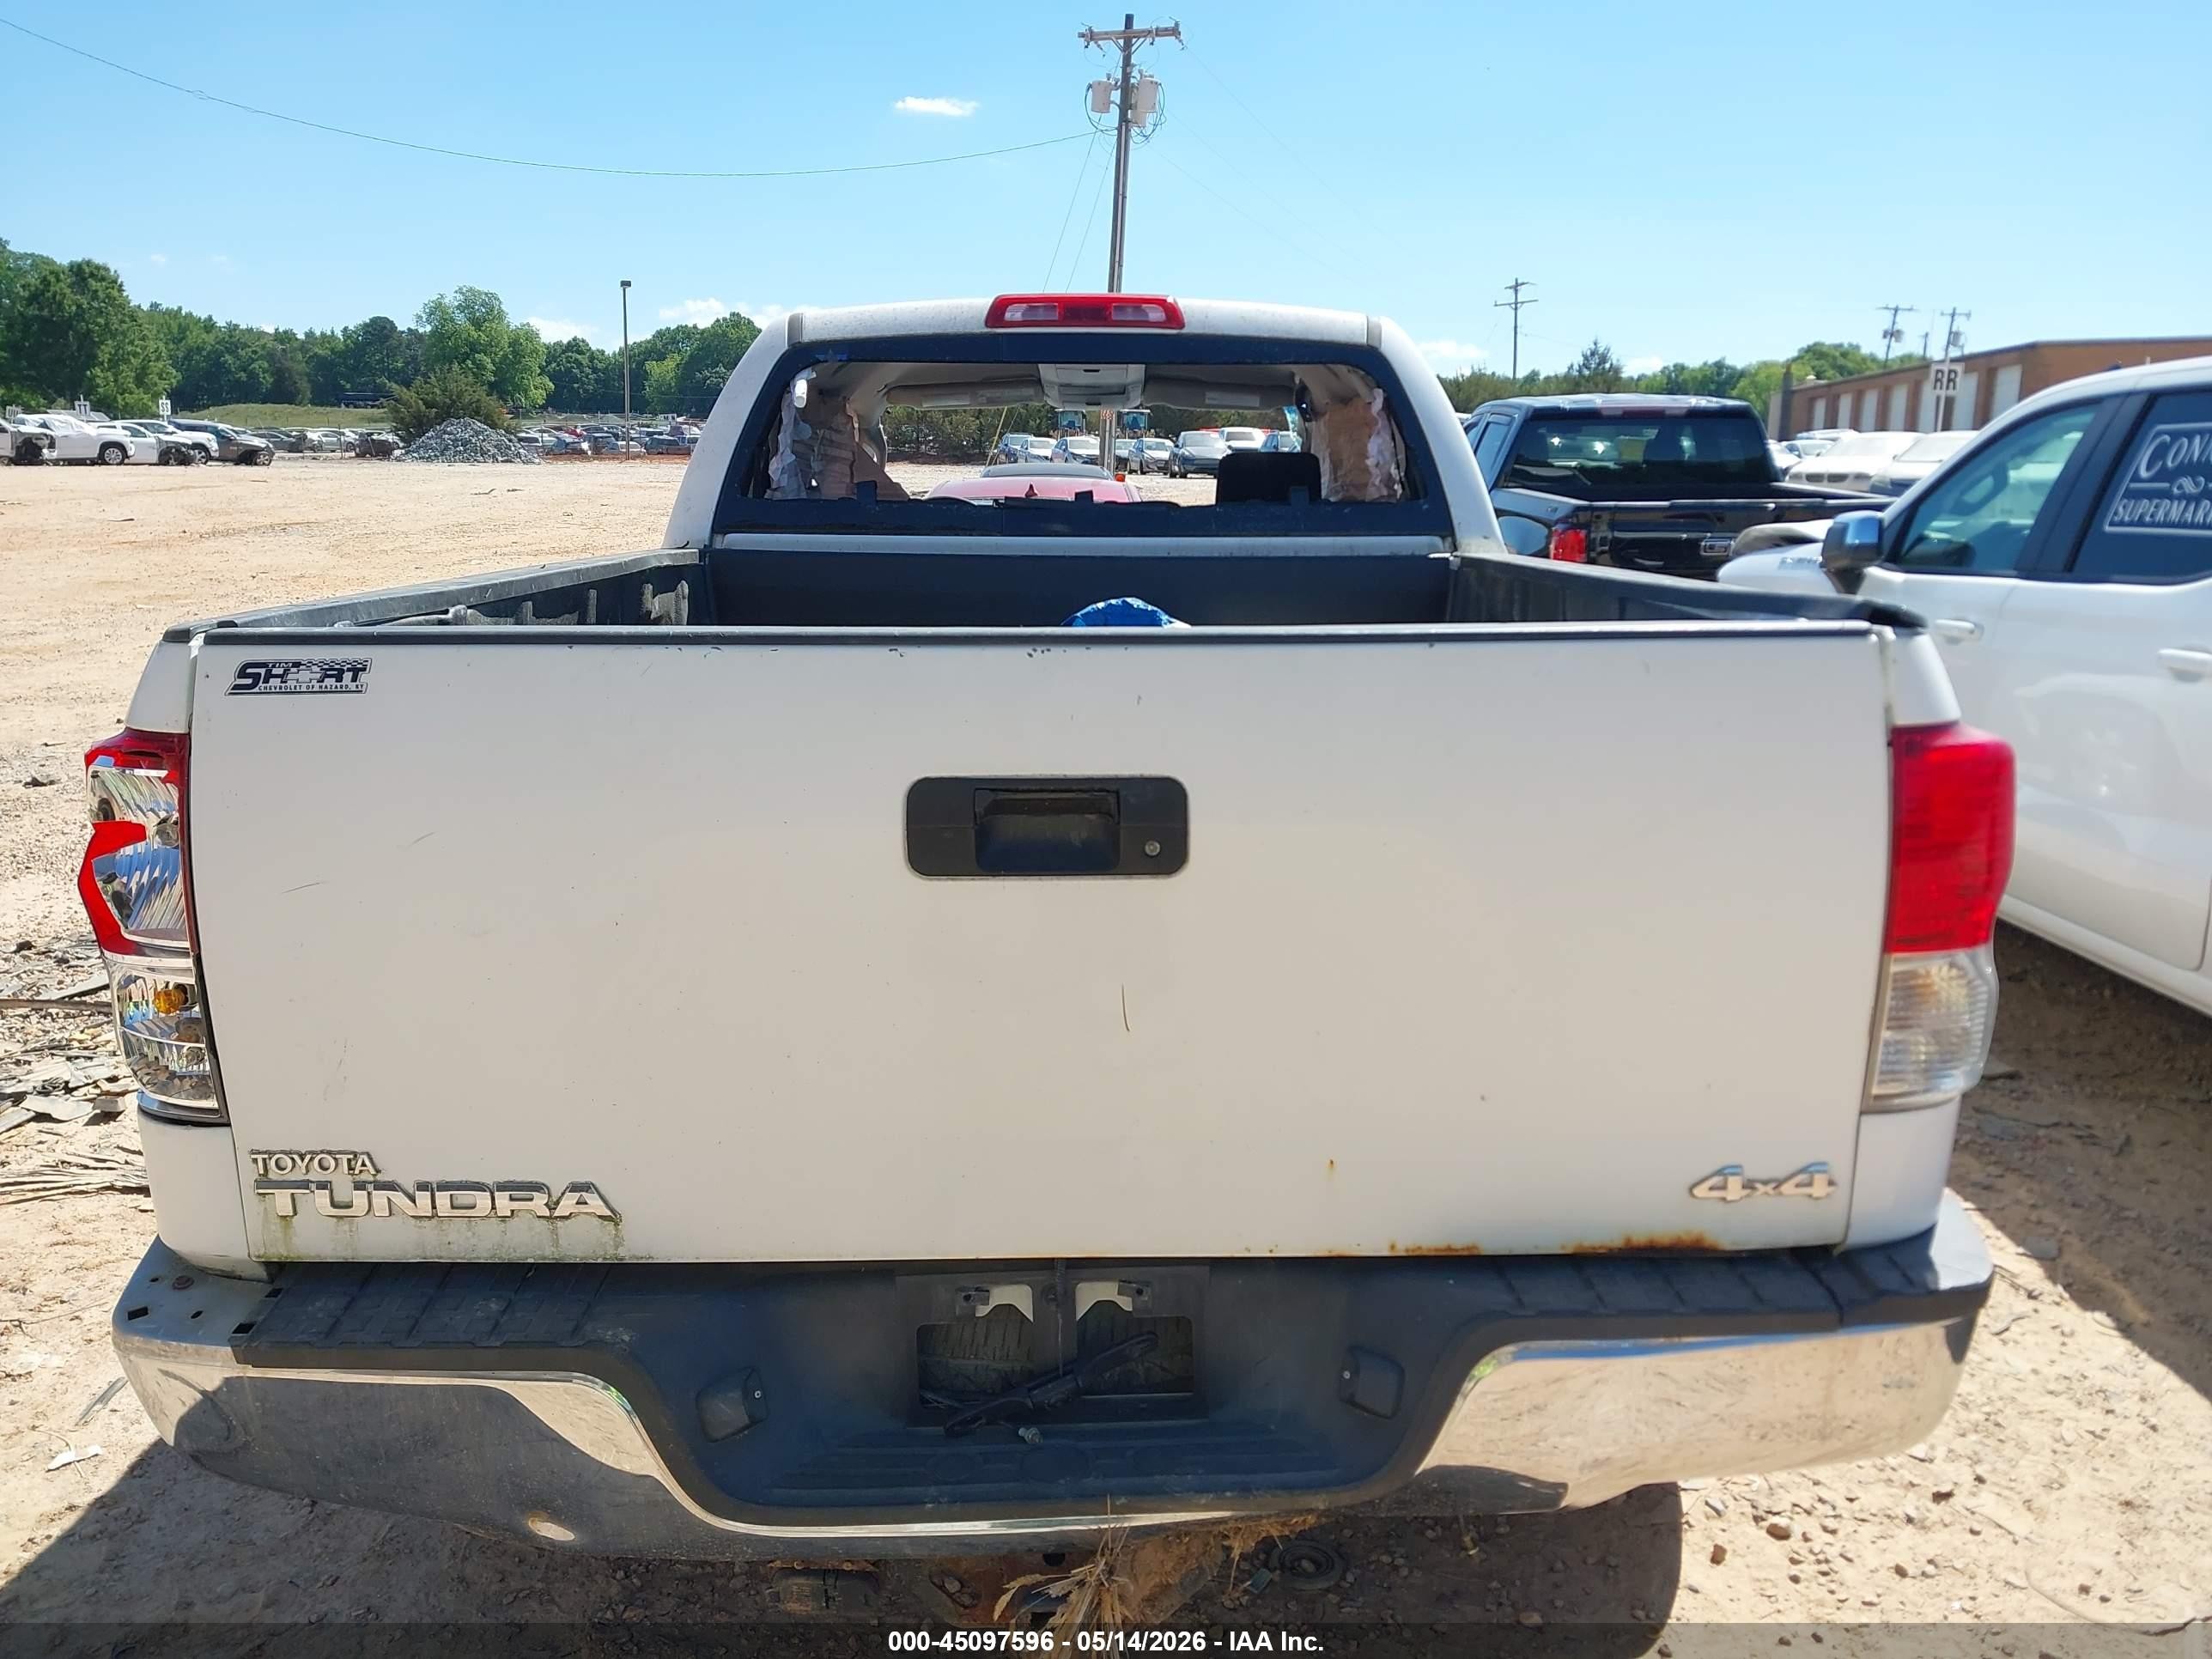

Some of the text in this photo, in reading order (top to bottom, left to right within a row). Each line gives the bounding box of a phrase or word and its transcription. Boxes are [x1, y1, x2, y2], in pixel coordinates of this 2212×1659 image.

[1933, 368, 1958, 391] RR
[77, 404, 88, 414] TT
[161, 401, 169, 412] SS
[251, 1151, 378, 1175] TOYOTA
[255, 1180, 620, 1219] TUNDRA
